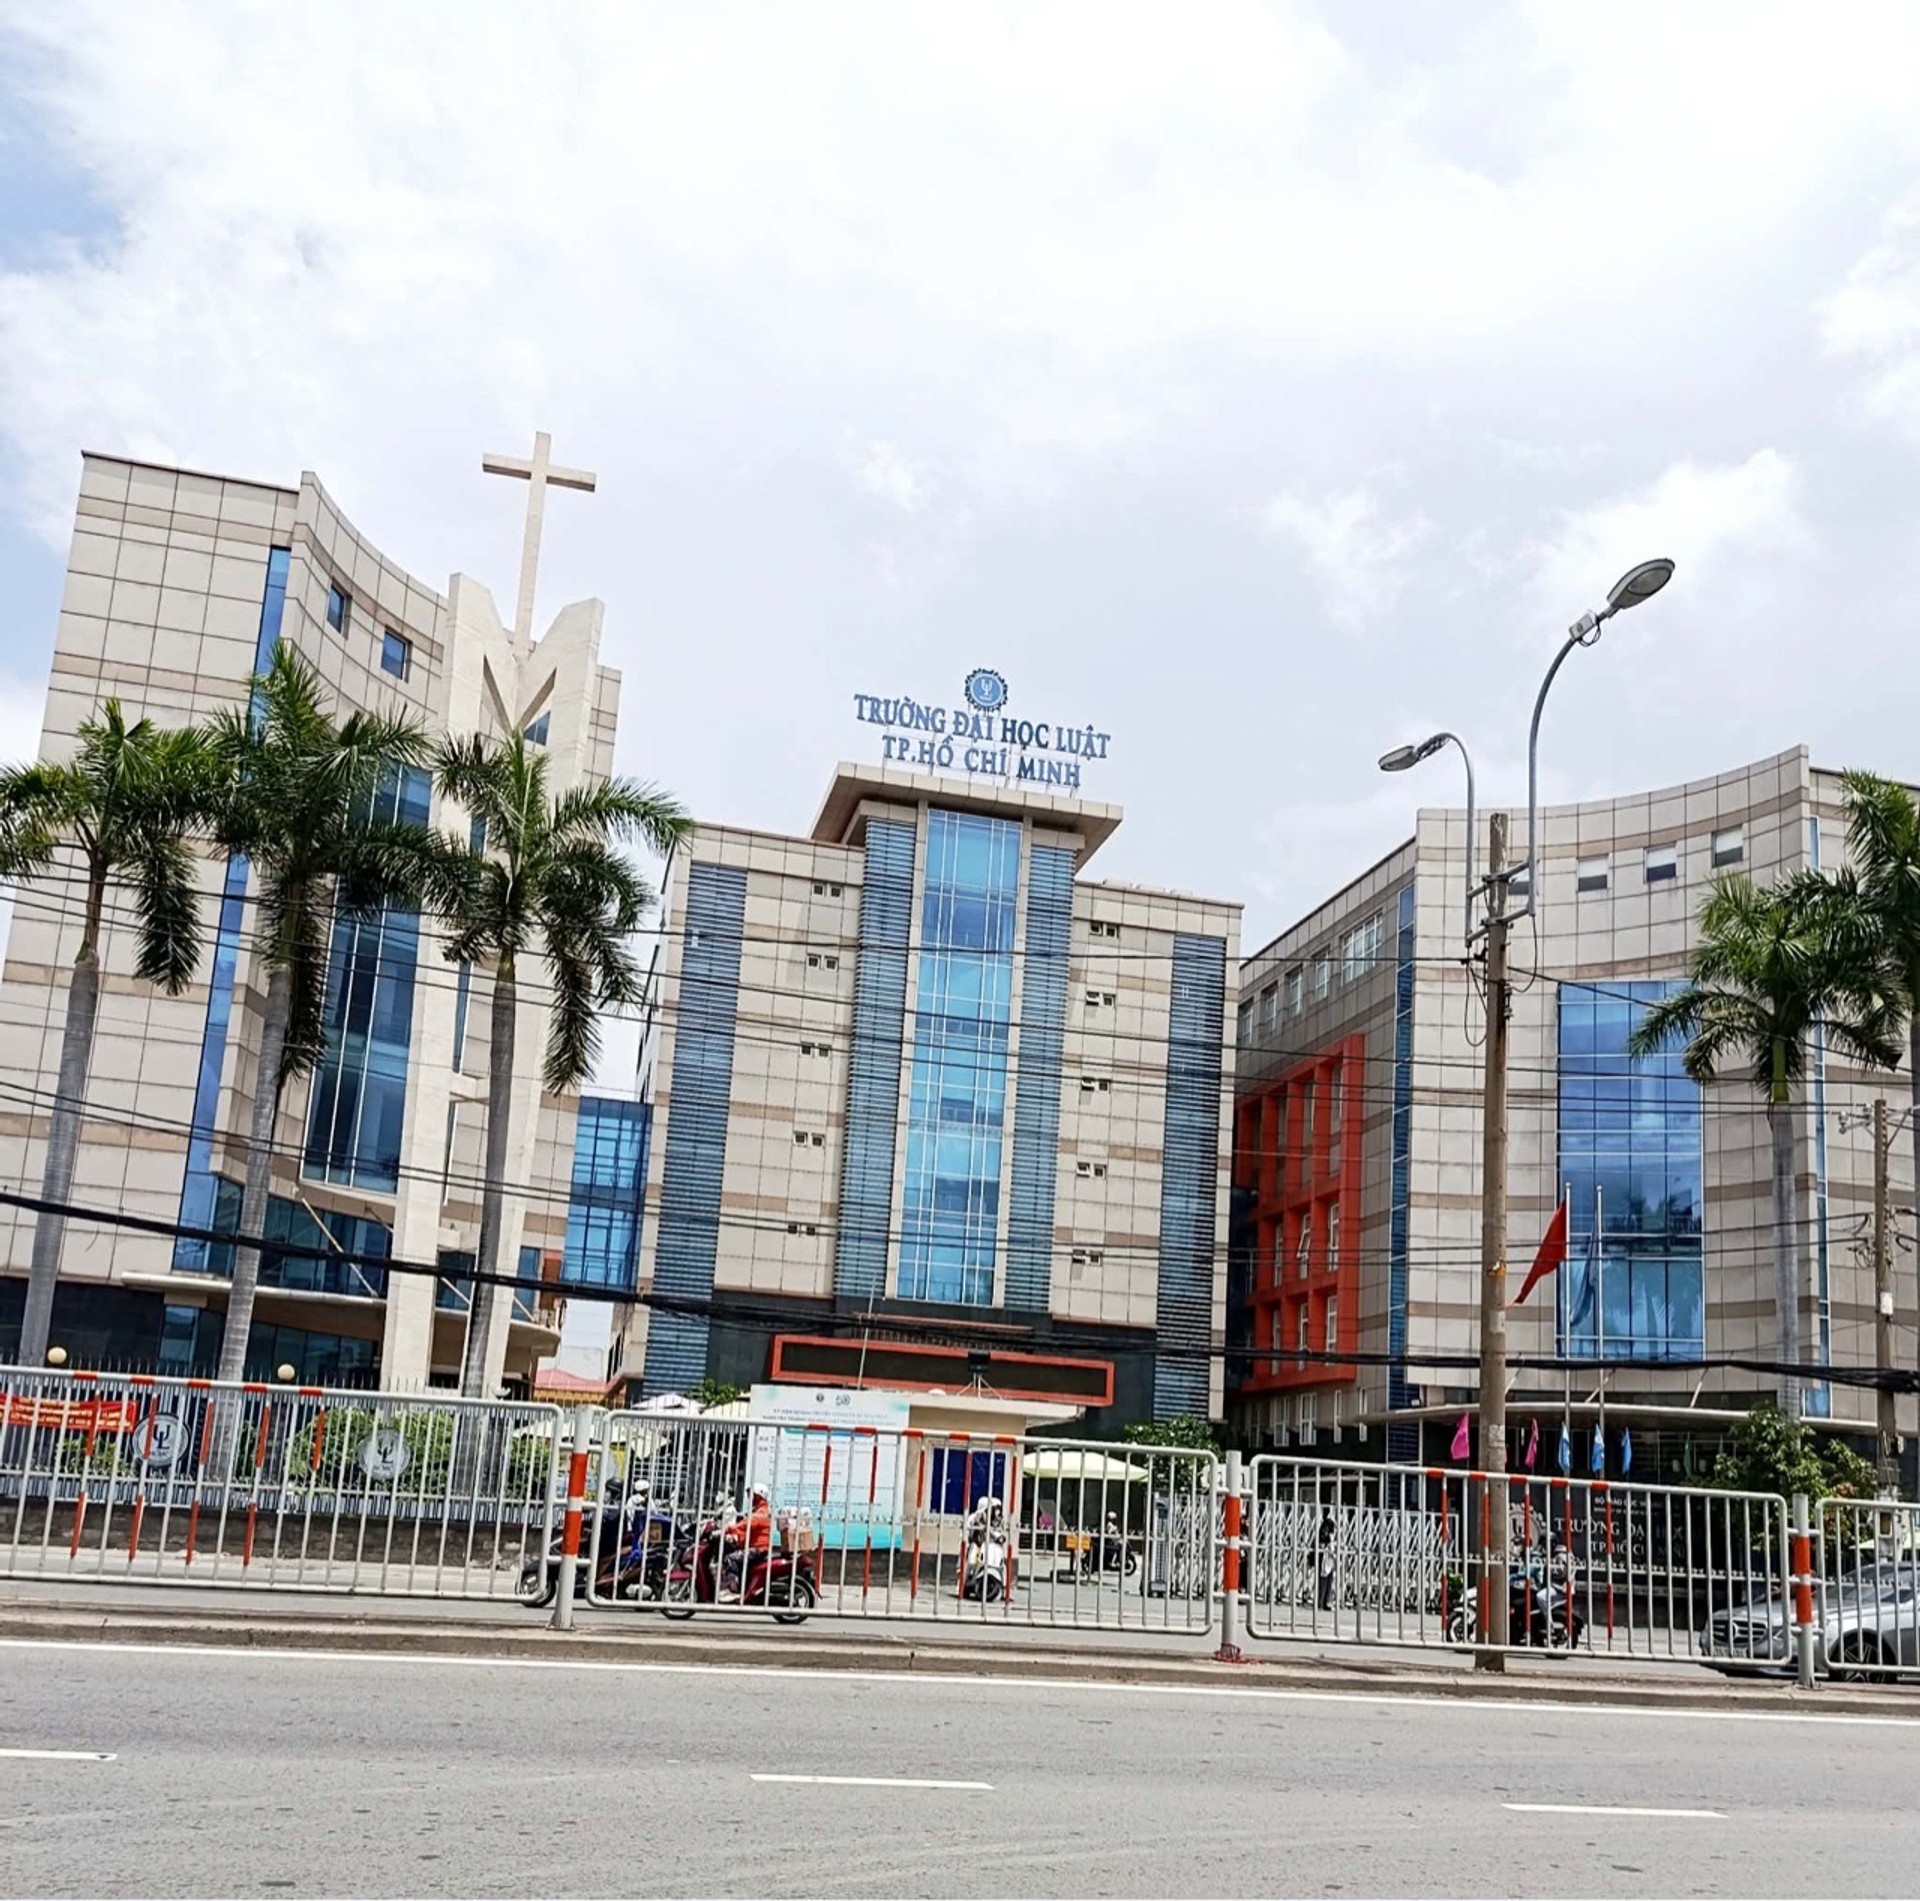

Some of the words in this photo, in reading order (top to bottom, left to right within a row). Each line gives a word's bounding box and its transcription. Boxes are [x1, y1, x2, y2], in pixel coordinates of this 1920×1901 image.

[854, 694, 946, 733] TRƯỜNG
[953, 710, 994, 743] ĐẠI
[1001, 718, 1049, 750] HỌC
[1056, 724, 1111, 760] LUẬT
[882, 735, 954, 768] TP.HỒ
[964, 747, 1007, 776] CHÍ
[1017, 755, 1081, 788] MINH
